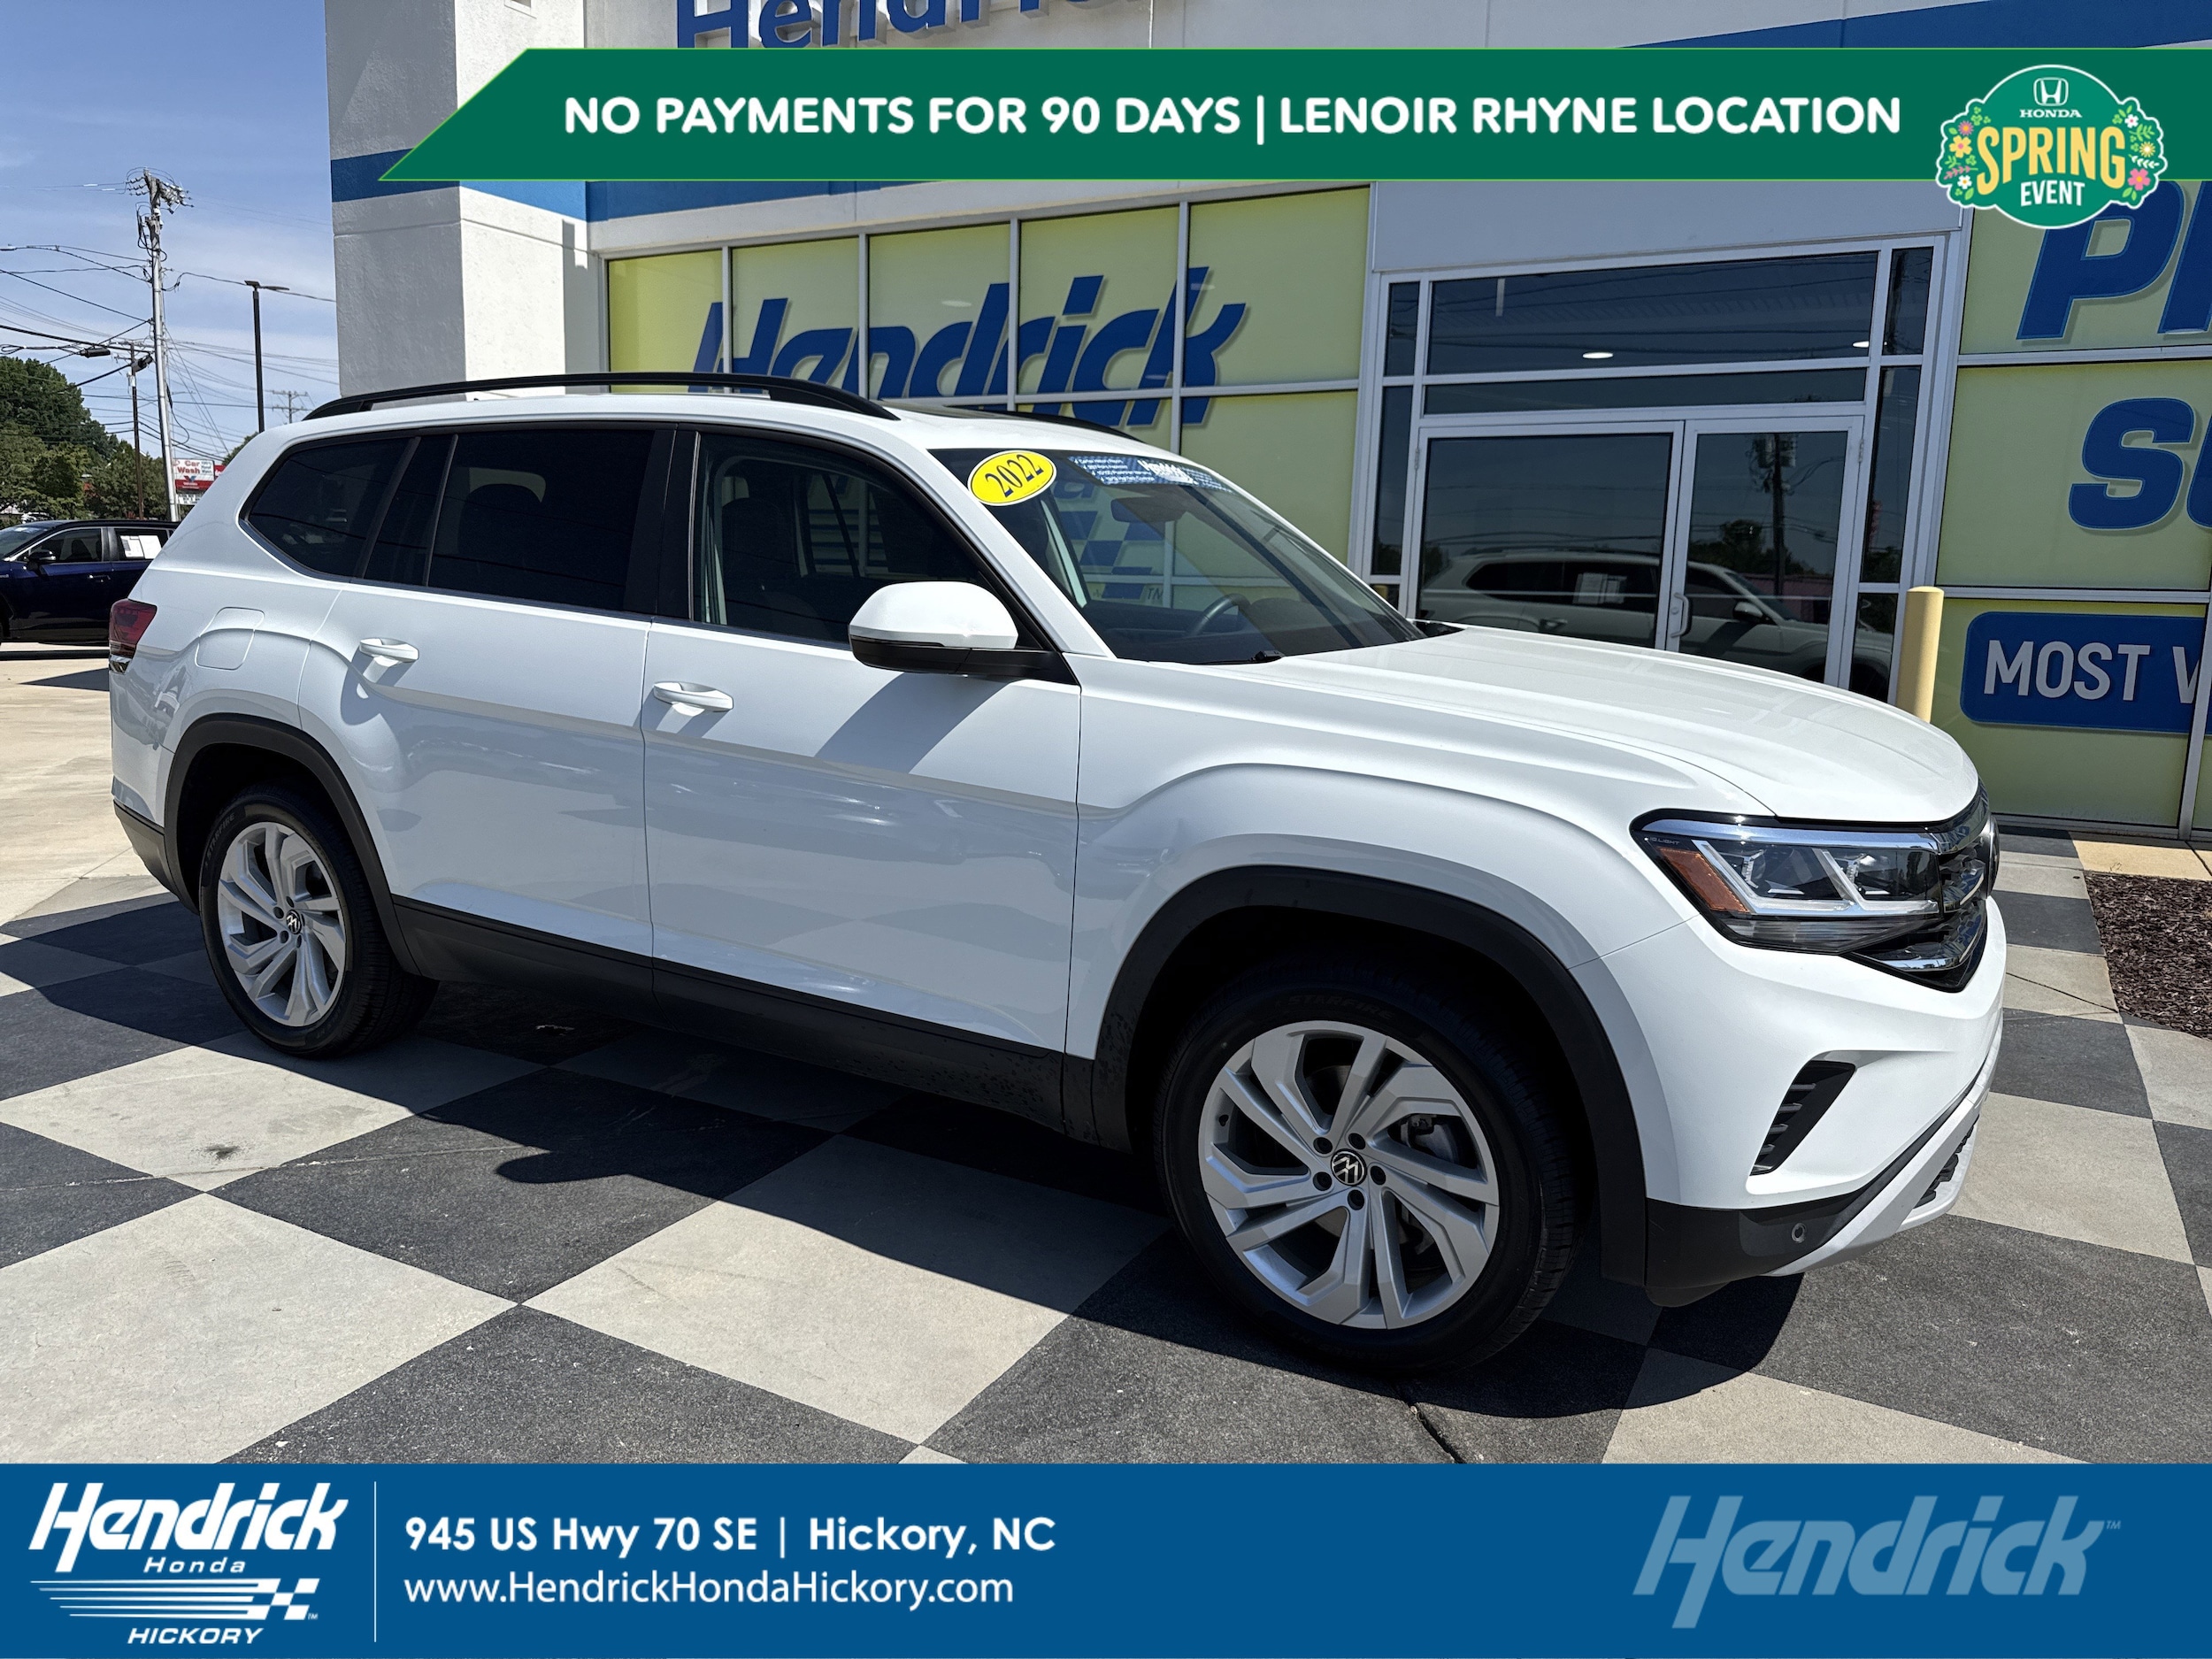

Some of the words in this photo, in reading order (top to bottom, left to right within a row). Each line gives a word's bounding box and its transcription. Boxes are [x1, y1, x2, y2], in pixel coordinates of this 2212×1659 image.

[2016, 180, 2212, 340] P
[688, 266, 1247, 426] Hendrick
[985, 454, 1044, 498] 2022
[1984, 640, 2151, 702] MOST
